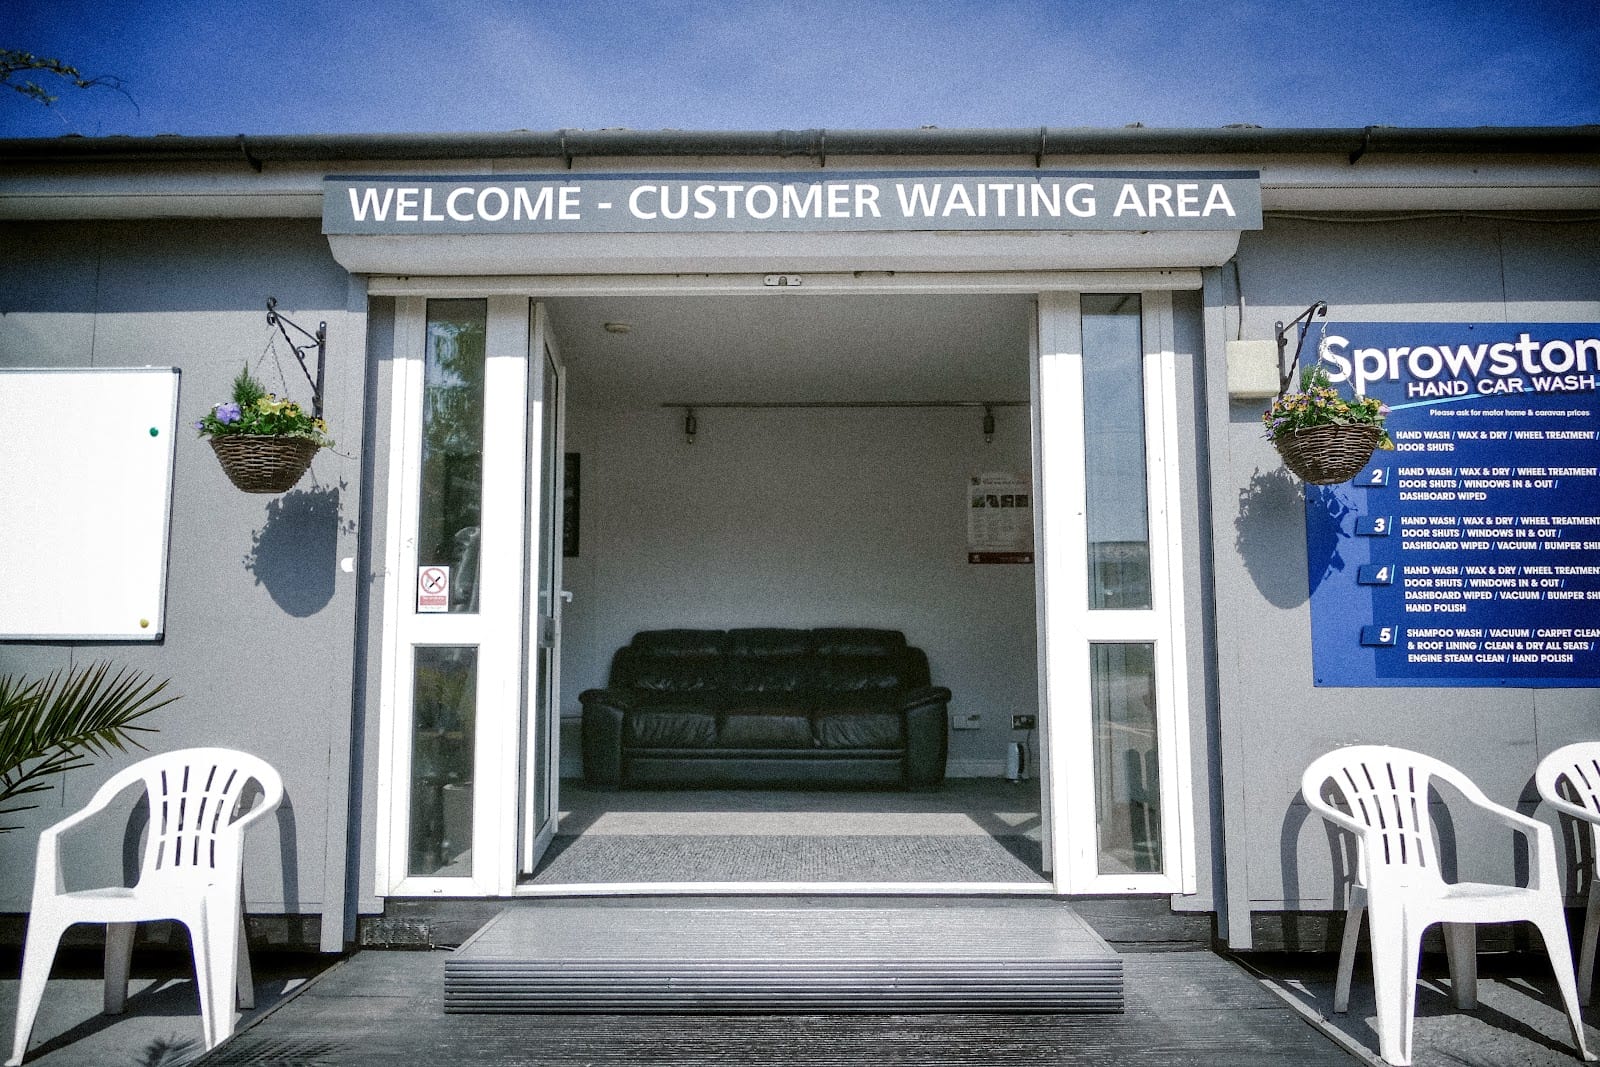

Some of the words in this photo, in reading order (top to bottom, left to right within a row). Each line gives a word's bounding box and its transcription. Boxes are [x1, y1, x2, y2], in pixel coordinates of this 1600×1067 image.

[348, 186, 581, 222] WELCOME
[628, 184, 882, 220] CUSTOMER
[896, 182, 1097, 218] WAITING
[1112, 182, 1236, 218] AREA
[1319, 333, 1600, 396] Sprowston
[1408, 380, 1469, 397] HAND
[1477, 377, 1524, 394] CAR
[1531, 375, 1596, 392] WASH
[1396, 431, 1422, 440] HAND
[1424, 431, 1450, 440] WASH
[1457, 431, 1479, 440] WAX
[1480, 431, 1488, 440] &
[1489, 431, 1507, 440] DRY
[1514, 431, 1544, 440] WHEEL
[1546, 431, 1594, 440] TREATMENT
[1397, 443, 1424, 451] DOOR
[1426, 443, 1455, 451] SHUTS
[1371, 469, 1383, 483] 2
[1398, 468, 1424, 476] HAND
[1426, 468, 1452, 476] WASH
[1460, 468, 1481, 476] WAX
[1482, 468, 1490, 476] &
[1491, 468, 1510, 476] DRY
[1517, 468, 1547, 476] WHEEL
[1548, 468, 1597, 476] TREATMENT
[1399, 480, 1427, 488] DOOR
[1428, 480, 1457, 488] SHUTS
[1464, 480, 1510, 488] WINDOWS
[1512, 480, 1523, 488] IN
[1524, 480, 1533, 488] &
[1534, 480, 1553, 488] OUT
[1400, 492, 1456, 500] DASHBOARD
[1457, 492, 1487, 500] WIPED
[1374, 518, 1385, 532] 3
[1401, 517, 1426, 525] HAND
[1428, 517, 1455, 525] WASH
[1462, 517, 1484, 525] WAX
[1485, 517, 1493, 525] &
[1494, 517, 1513, 525] DRY
[1520, 517, 1550, 525] WHEEL
[1402, 529, 1429, 538] DOOR
[1431, 529, 1459, 538] SHUTS
[1467, 529, 1514, 538] WINDOWS
[1515, 529, 1526, 538] IN
[1528, 529, 1536, 538] &
[1537, 529, 1556, 538] OUT
[1403, 541, 1458, 550] DASHBOARD
[1460, 541, 1490, 550] WIPED
[1497, 541, 1537, 550] VACUUM
[1544, 541, 1582, 550] BUMPER
[1376, 567, 1388, 581] 4
[1404, 566, 1430, 575] HAND
[1431, 566, 1458, 575] WASH
[1465, 566, 1487, 575] WAX
[1488, 566, 1496, 575] &
[1498, 566, 1516, 575] DRY
[1523, 566, 1553, 575] WHEEL
[1554, 566, 1600, 575] TREATMEN
[1404, 579, 1432, 587] DOOR
[1434, 579, 1462, 587] SHUTS
[1469, 579, 1517, 587] WINDOWS
[1518, 579, 1529, 587] IN
[1531, 579, 1538, 587] &
[1540, 579, 1559, 587] OUT
[1405, 591, 1461, 600] DASHBOARD
[1463, 591, 1492, 600] WIPED
[1499, 591, 1540, 600] VACUUM
[1547, 591, 1585, 600] BUMPER
[1406, 604, 1432, 612] HAND
[1434, 604, 1466, 612] POLISH
[1379, 628, 1391, 642] 5
[1407, 629, 1453, 638] SHAMPOO
[1455, 629, 1482, 638] WASH
[1489, 629, 1529, 638] VACUUM
[1536, 629, 1572, 638] CARPET
[1407, 642, 1415, 650] &
[1417, 642, 1444, 650] ROOF
[1445, 642, 1477, 650] LINING
[1484, 642, 1514, 650] CLEAN
[1516, 642, 1524, 650] &
[1525, 642, 1544, 650] DRY
[1545, 642, 1562, 650] ALL
[1563, 642, 1589, 650] SEATS
[1408, 654, 1442, 663] ENGINE
[1444, 654, 1473, 663] STEAM
[1475, 654, 1505, 663] CLEAN
[1512, 654, 1539, 663] HAND
[1541, 654, 1573, 663] POLISH
